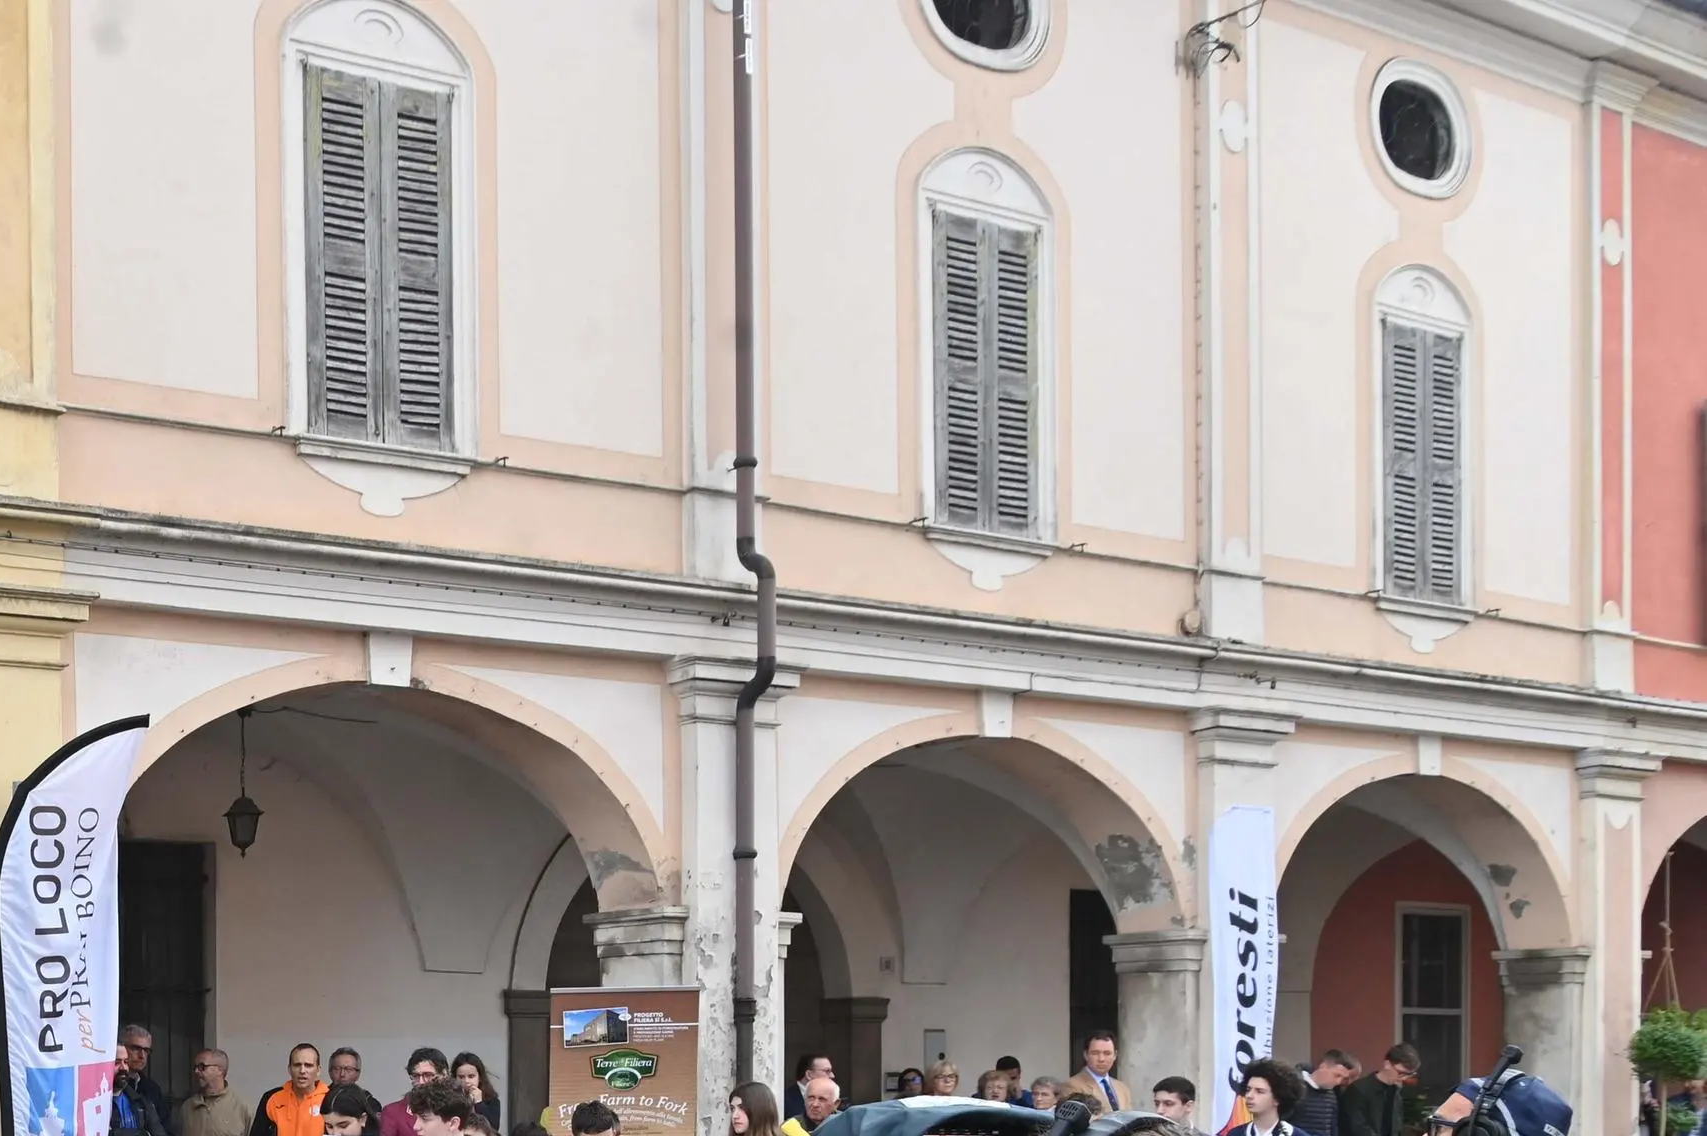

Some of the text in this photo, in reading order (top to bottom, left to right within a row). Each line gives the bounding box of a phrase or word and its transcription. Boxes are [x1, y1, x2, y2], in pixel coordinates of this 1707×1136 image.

[29, 804, 72, 1054] PRO LOCO
[69, 807, 107, 1054] per PRBOINO
[1263, 974, 1274, 1058] ibuzione
[598, 1094, 635, 1106] Farm
[639, 1095, 654, 1107] to
[655, 1096, 689, 1115] Fork
